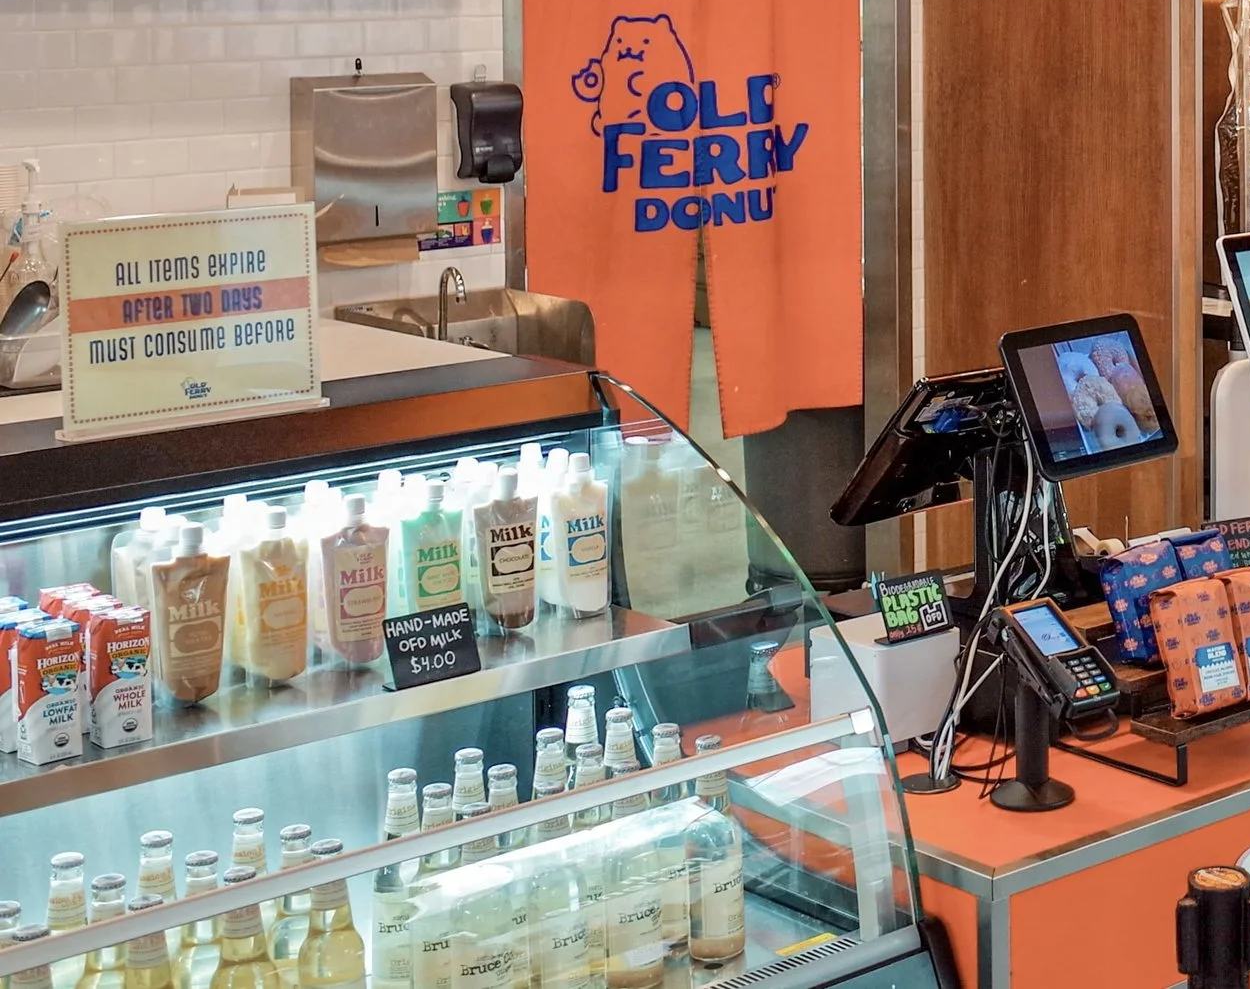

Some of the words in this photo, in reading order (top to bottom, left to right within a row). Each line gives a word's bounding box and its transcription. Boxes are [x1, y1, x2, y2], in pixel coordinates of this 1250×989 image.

[603, 122, 809, 192] FERRY
[634, 187, 777, 232] DONU
[115, 261, 141, 286] ALL
[123, 295, 174, 324] AFTER
[181, 290, 213, 317] TWO
[221, 285, 262, 313] DAYS
[89, 336, 136, 364] MUST
[144, 325, 226, 358] CONSUME
[234, 317, 295, 347] BEFORE
[567, 514, 605, 533] Milk
[490, 525, 534, 543] Milk
[1227, 537, 1250, 550] END
[418, 543, 458, 562] Milk
[340, 566, 384, 586] Milk
[259, 577, 304, 598] Milk
[882, 583, 942, 612] PLASTIC
[169, 601, 219, 622] Milk
[885, 607, 919, 627] BAG
[926, 611, 942, 623] OFD
[386, 608, 470, 638] HAND-MADE
[107, 637, 150, 653] HORIZON
[399, 634, 427, 652] OFD
[430, 628, 463, 649] MILK
[37, 652, 80, 670] HORIZON
[112, 648, 147, 659] ORGANIC
[411, 650, 456, 674] $4.00
[42, 664, 77, 675] ORGANIC
[113, 690, 146, 702] WHOLE
[118, 699, 143, 710] MILK
[43, 704, 78, 718] LOWFAT
[49, 714, 74, 726] MILK
[713, 875, 743, 894] Bruc
[378, 921, 410, 934] Bruc
[552, 929, 586, 950] Bruc
[460, 960, 501, 977] Bruce
